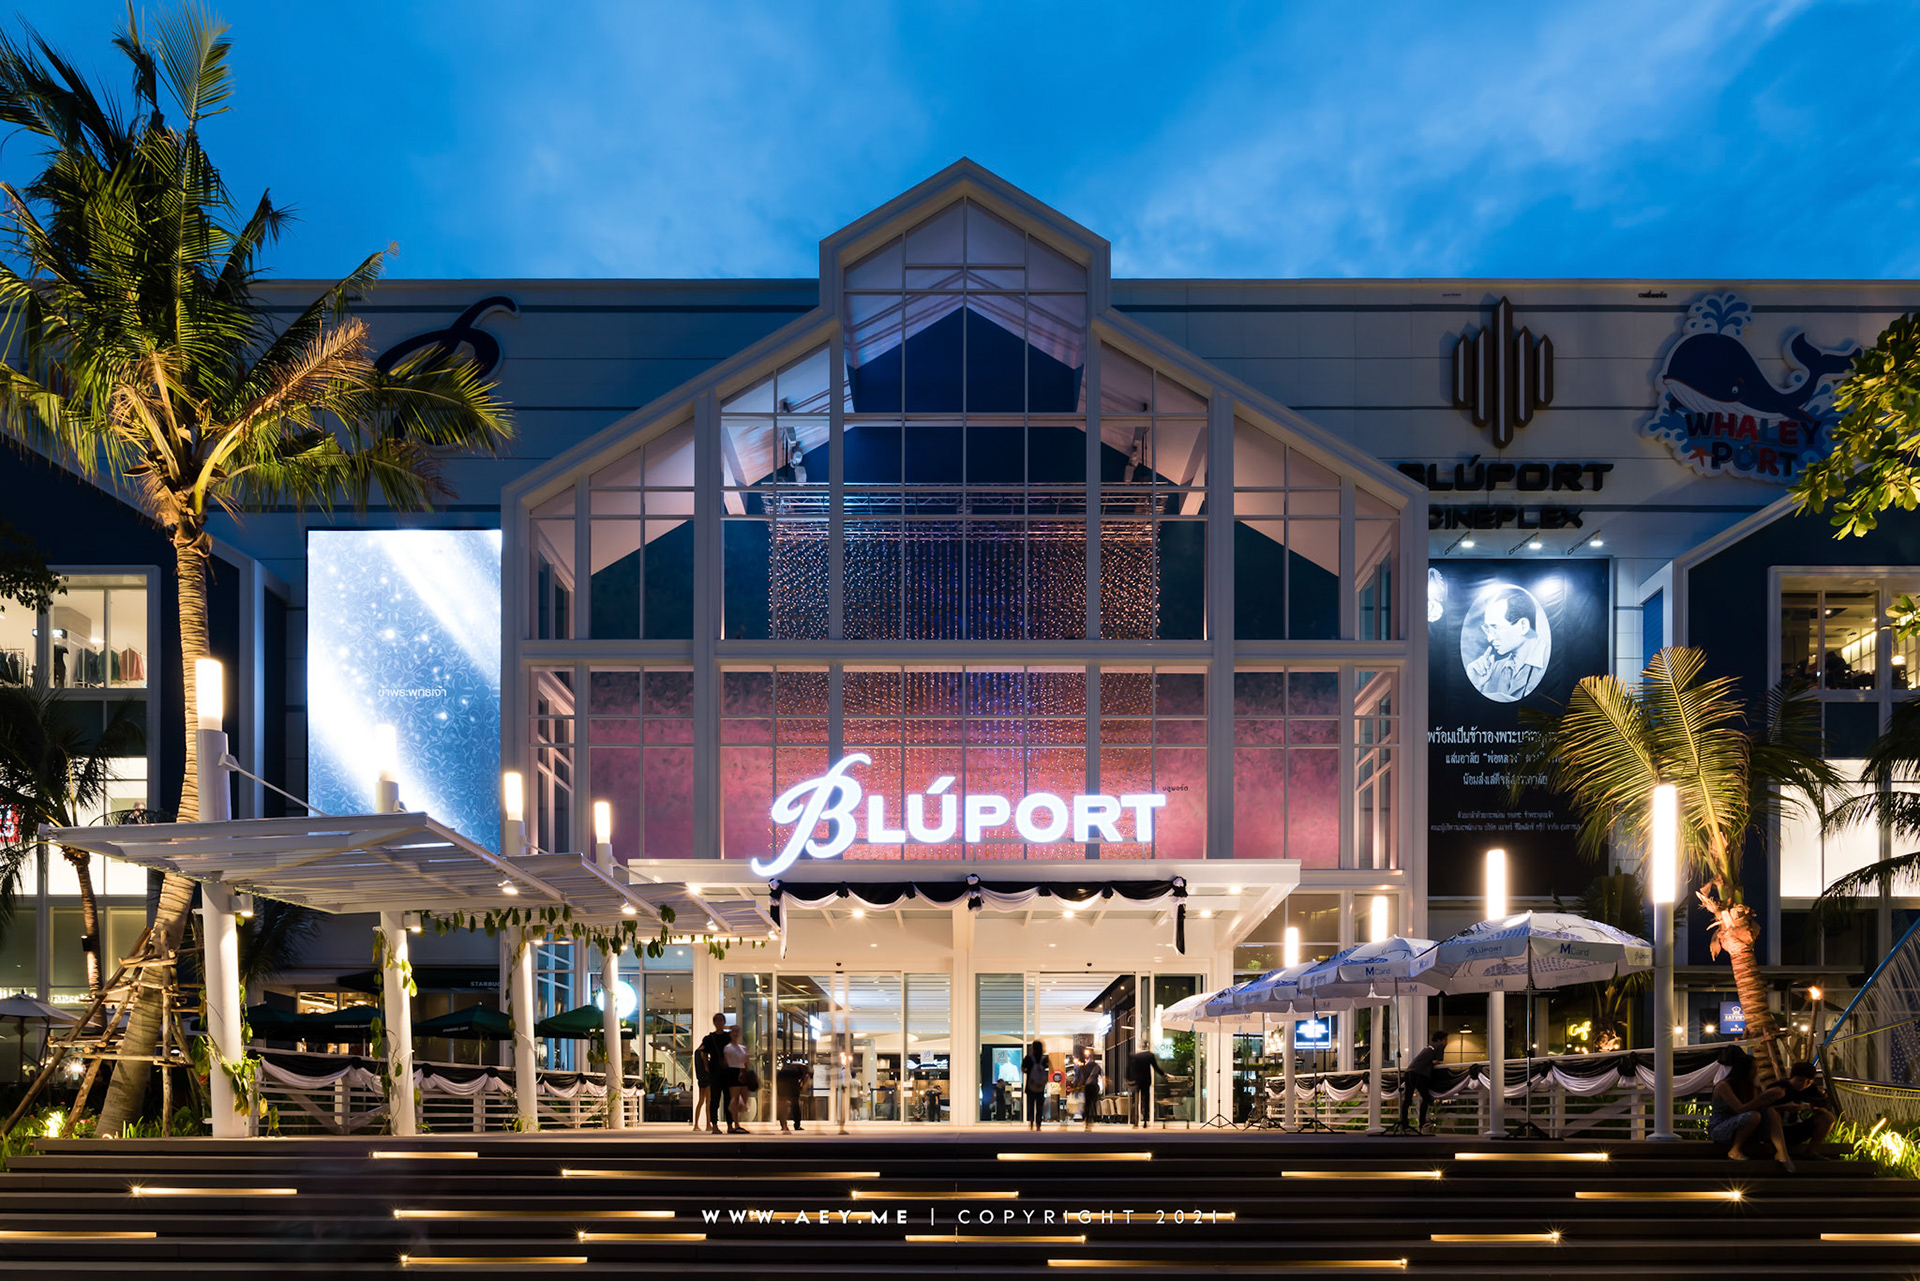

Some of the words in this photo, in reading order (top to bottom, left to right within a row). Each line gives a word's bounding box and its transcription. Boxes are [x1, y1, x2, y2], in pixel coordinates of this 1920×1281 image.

[1684, 411, 1823, 448] WHALEY
[1711, 441, 1799, 477] PORT
[749, 752, 1168, 877] BLÚPORT
